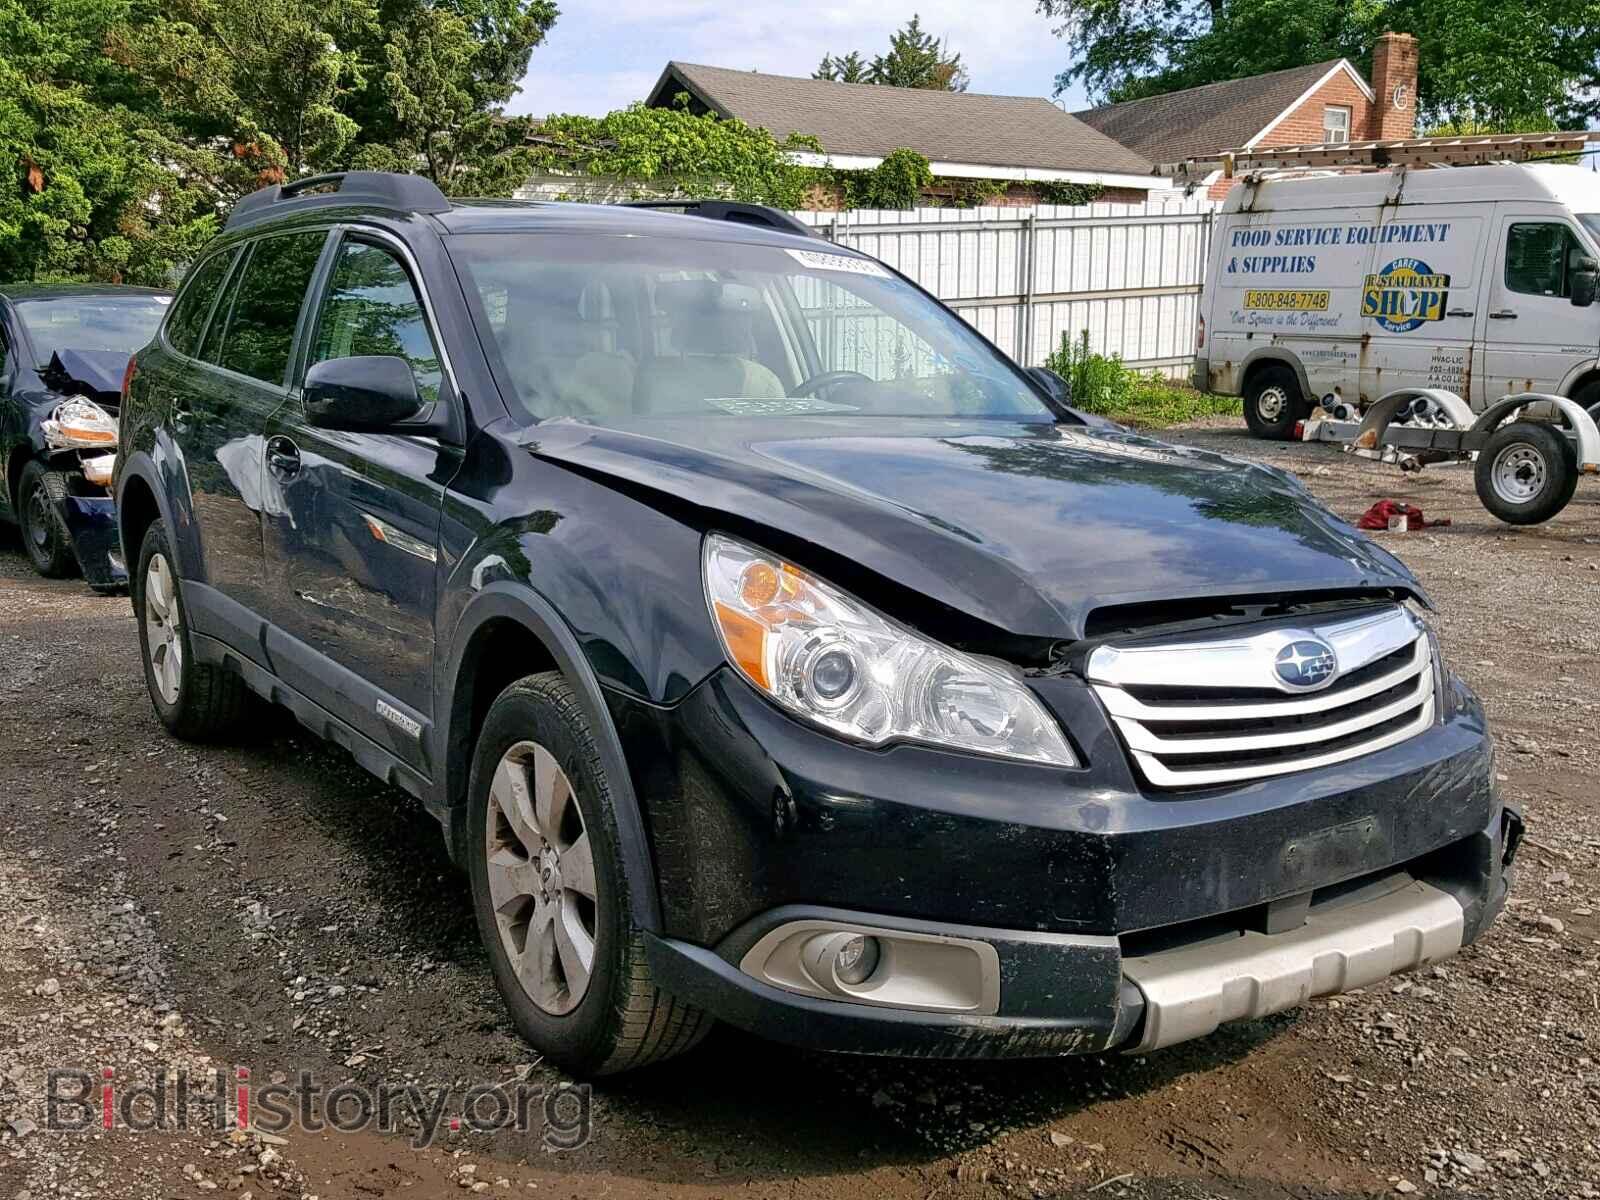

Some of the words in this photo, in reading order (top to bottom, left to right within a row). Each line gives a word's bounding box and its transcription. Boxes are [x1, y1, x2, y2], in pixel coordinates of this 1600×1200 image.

[1232, 229, 1271, 248] FOOD
[1275, 227, 1342, 246] SERVICE
[1346, 223, 1451, 244] EQUIPMENT
[1227, 256, 1238, 273] &
[1242, 255, 1317, 273] SUPPLIES
[1246, 292, 1328, 309] 1-800-848-7748
[1365, 290, 1439, 318] SHOP
[1286, 312, 1298, 327] the
